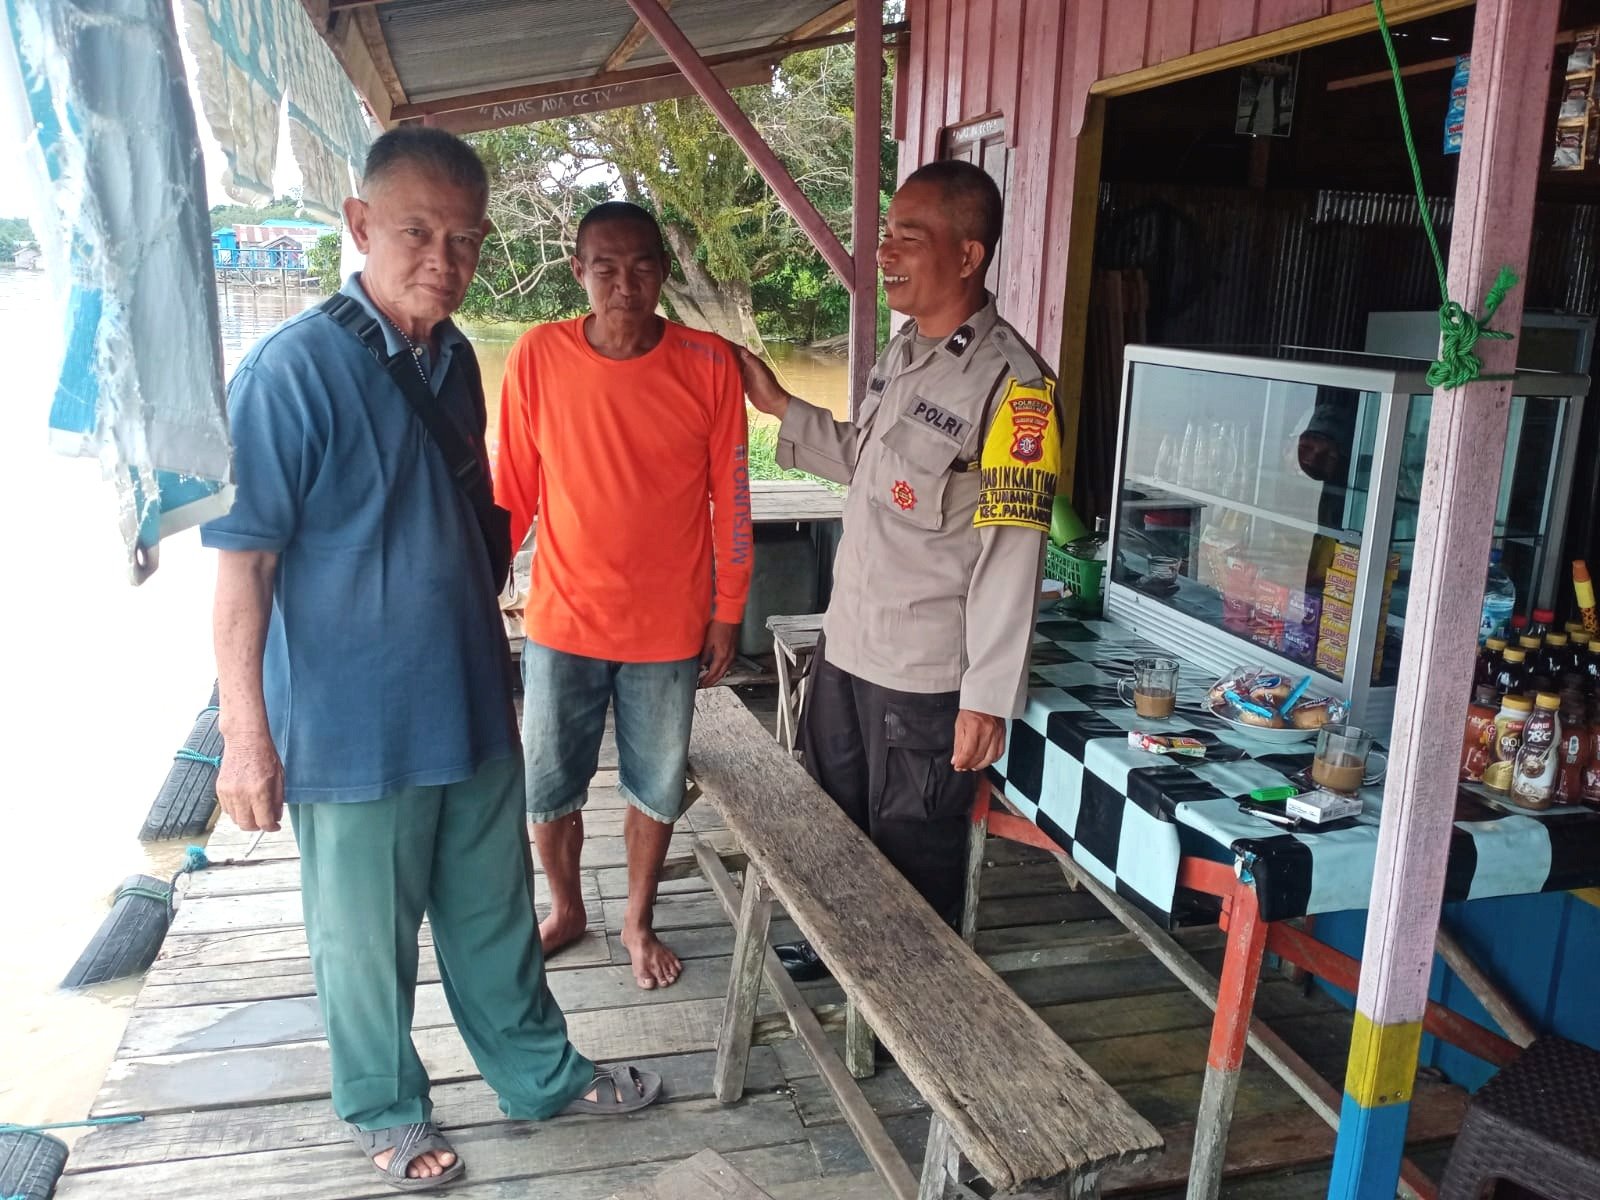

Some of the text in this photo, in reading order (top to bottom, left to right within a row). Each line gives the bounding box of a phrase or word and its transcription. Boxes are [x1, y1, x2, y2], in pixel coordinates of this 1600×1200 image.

[541, 97, 567, 113] ADA
[913, 402, 963, 437] POLRI
[730, 466, 750, 565] MITSUNO
